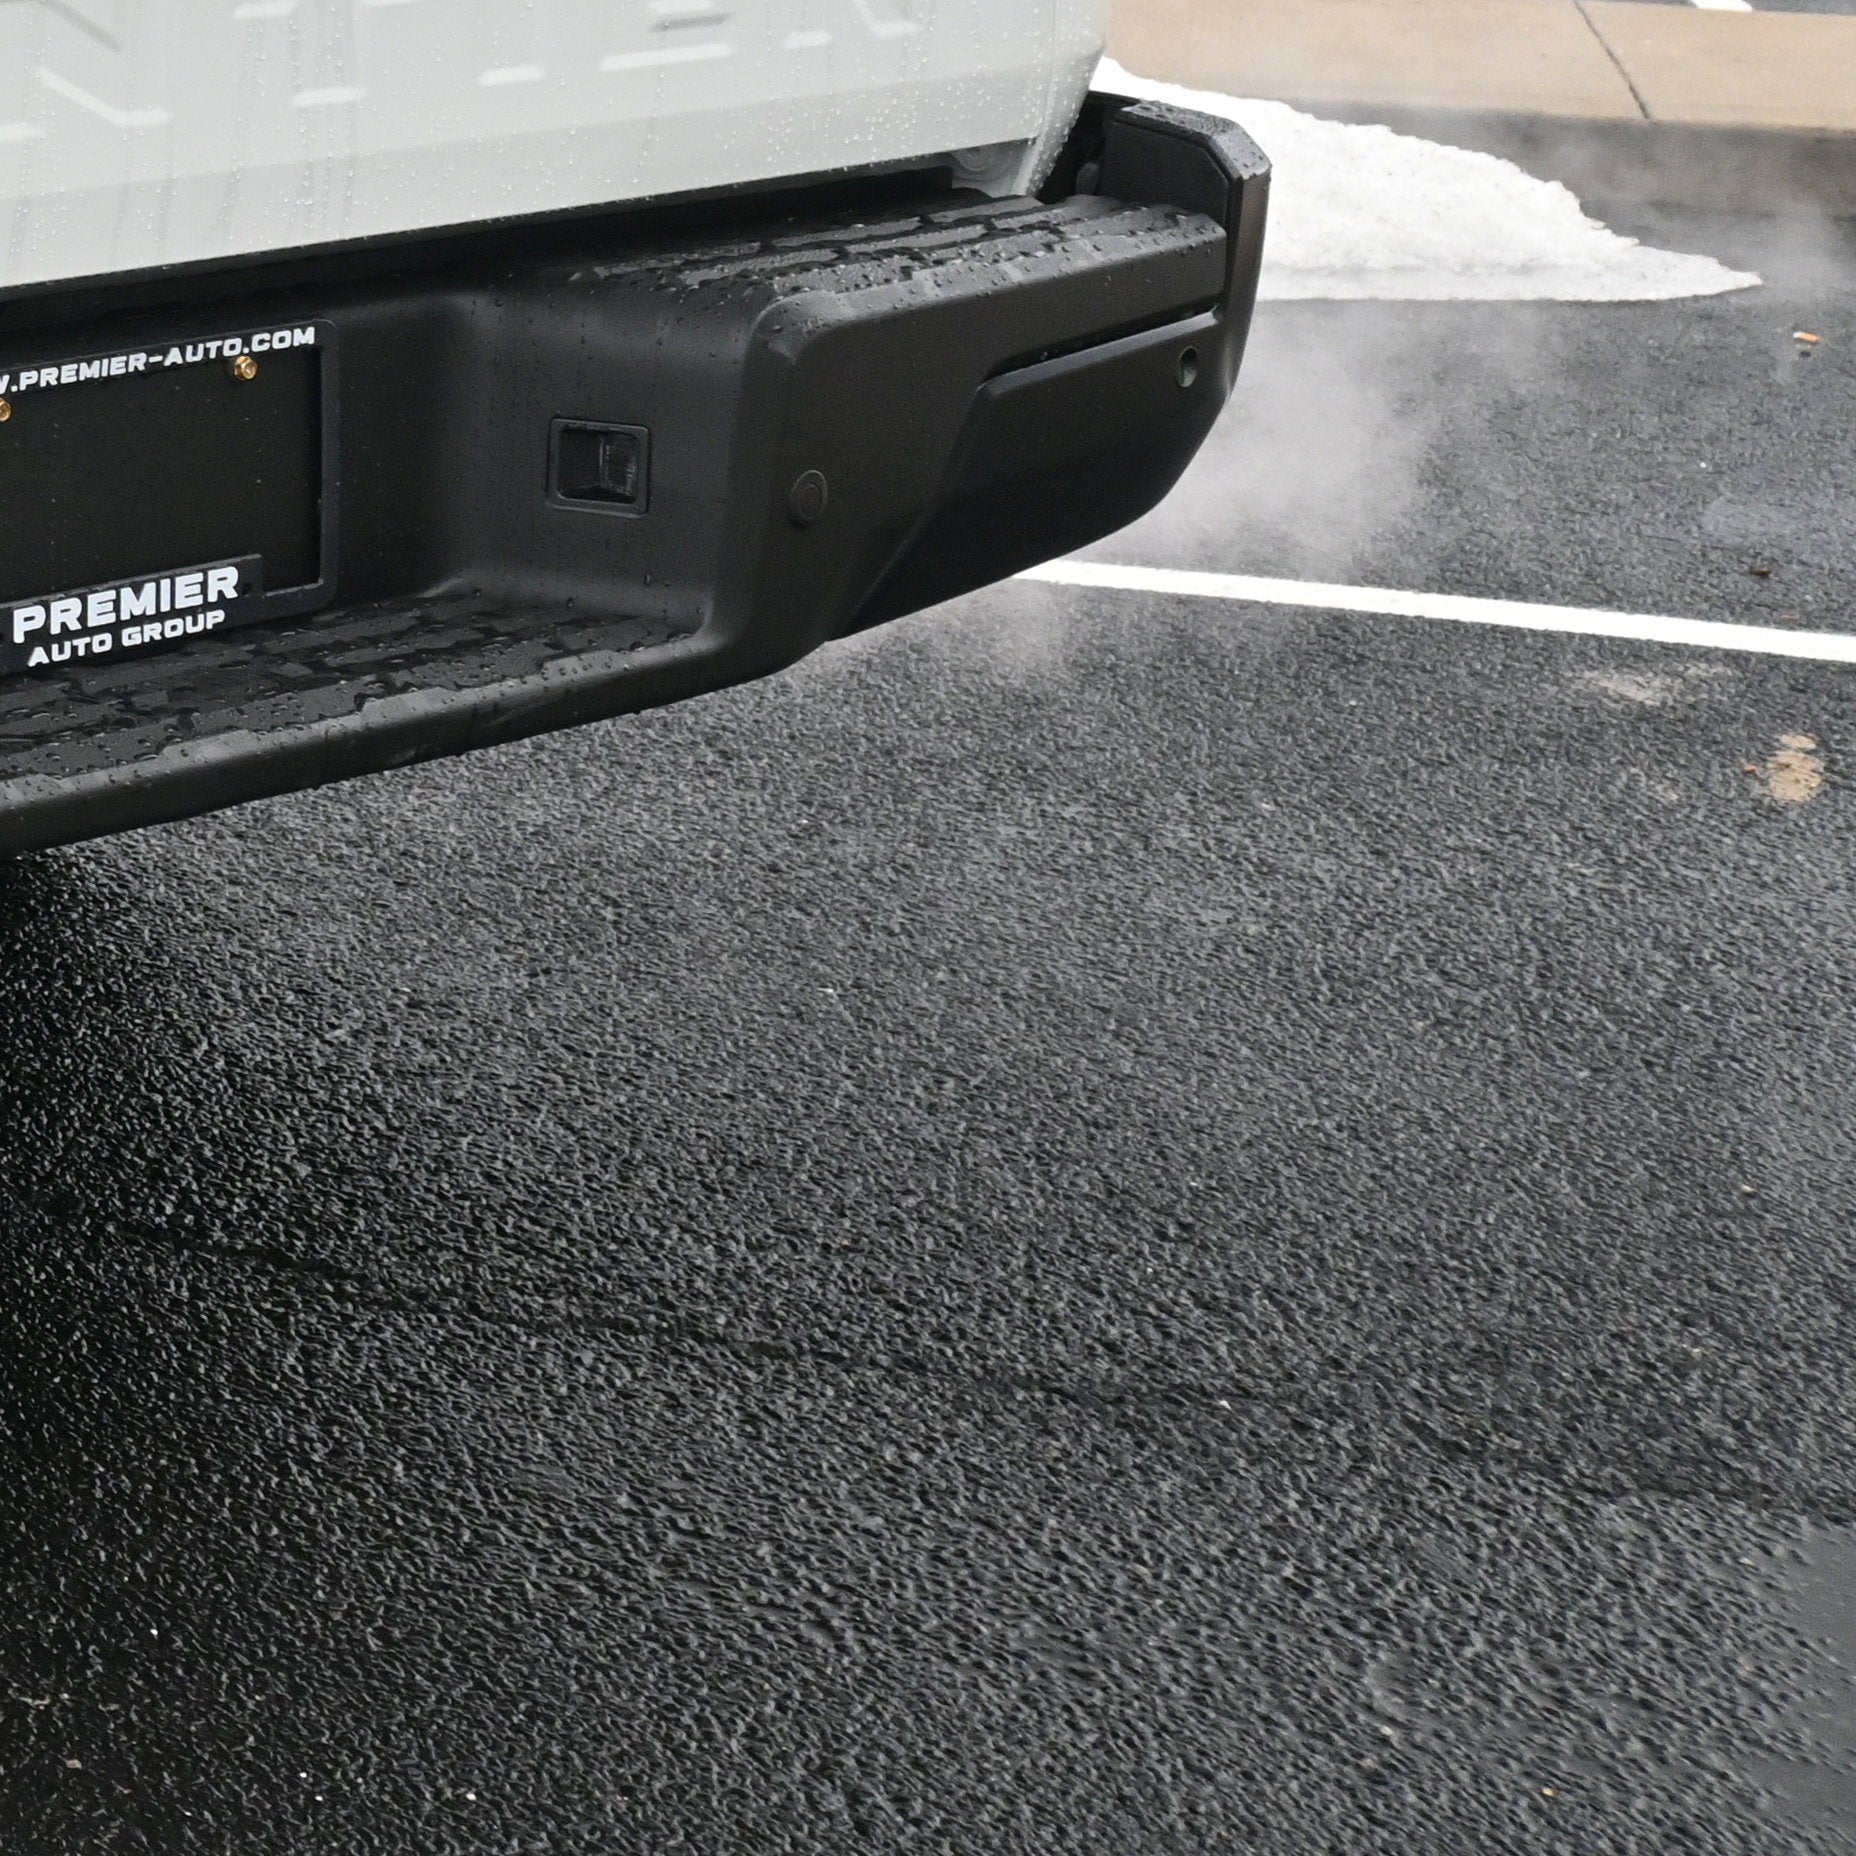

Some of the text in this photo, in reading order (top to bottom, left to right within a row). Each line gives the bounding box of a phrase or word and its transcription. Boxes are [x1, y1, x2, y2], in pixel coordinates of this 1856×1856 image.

[12, 565, 239, 644] PREMIER
[26, 609, 225, 667] AUTO GROUP
